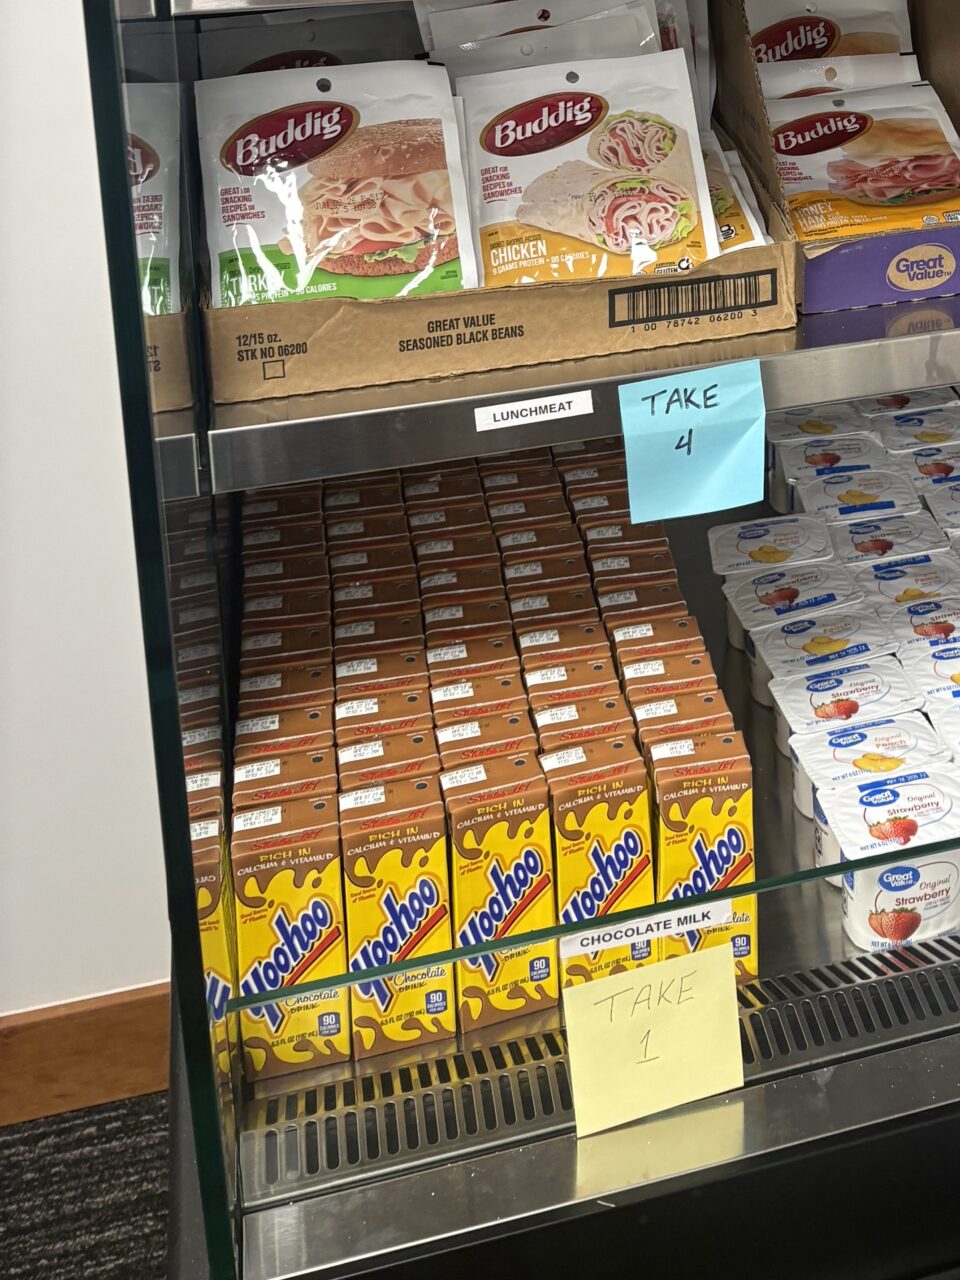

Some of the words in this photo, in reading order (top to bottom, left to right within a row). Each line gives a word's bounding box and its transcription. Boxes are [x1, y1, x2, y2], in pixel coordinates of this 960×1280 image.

[753, 21, 831, 63] Buddig
[495, 96, 593, 148] Buddig
[777, 112, 860, 150] Buddig
[236, 107, 343, 166] Buddig
[481, 166, 499, 176] GREAT
[482, 173, 510, 184] SNACKING
[482, 181, 506, 191] RECIPES
[483, 186, 523, 200] SANDWICHES
[490, 240, 548, 267] CHICKEN
[498, 262, 517, 274] GRAMS
[518, 258, 545, 269] PROTEIN
[895, 254, 944, 273] Great
[907, 268, 944, 282] Value
[427, 317, 460, 333] GREAT
[463, 314, 496, 329] VALUE
[644, 323, 657, 331] 00
[666, 317, 700, 329] 78742
[709, 312, 743, 323] 06200
[235, 333, 264, 347] 12/15
[267, 334, 281, 343] oz.
[399, 333, 453, 352] SEASONED
[456, 329, 489, 345] BLACK
[492, 325, 524, 341] BEANS
[237, 349, 258, 362] STK
[260, 346, 275, 359] NO
[278, 342, 308, 357] 06200
[641, 384, 720, 416] TAKE
[493, 400, 574, 423] LUNCHMEAT
[674, 428, 693, 455] 4
[831, 685, 880, 699] Strawberry
[875, 739, 907, 750] Peach
[663, 787, 698, 801] CALCIUM
[709, 784, 740, 795] VITAMIN
[683, 777, 712, 789] RICH
[716, 777, 728, 786] IN
[887, 800, 940, 817] Strawberry
[369, 830, 396, 842] RICH
[405, 826, 419, 835] IN
[347, 841, 387, 856] CALCIUM
[398, 834, 433, 845] VITAMIN
[883, 871, 914, 883] Great
[890, 878, 914, 887] Value
[919, 874, 951, 891] Original
[895, 886, 951, 907] Strawberry
[580, 918, 673, 949] CHOCOLATE
[676, 909, 712, 930] MILK
[534, 960, 545, 970] 90
[394, 967, 447, 986] Chocolate
[429, 993, 442, 1003] 90
[593, 969, 697, 1024] TAKE
[636, 1029, 660, 1065] 1
